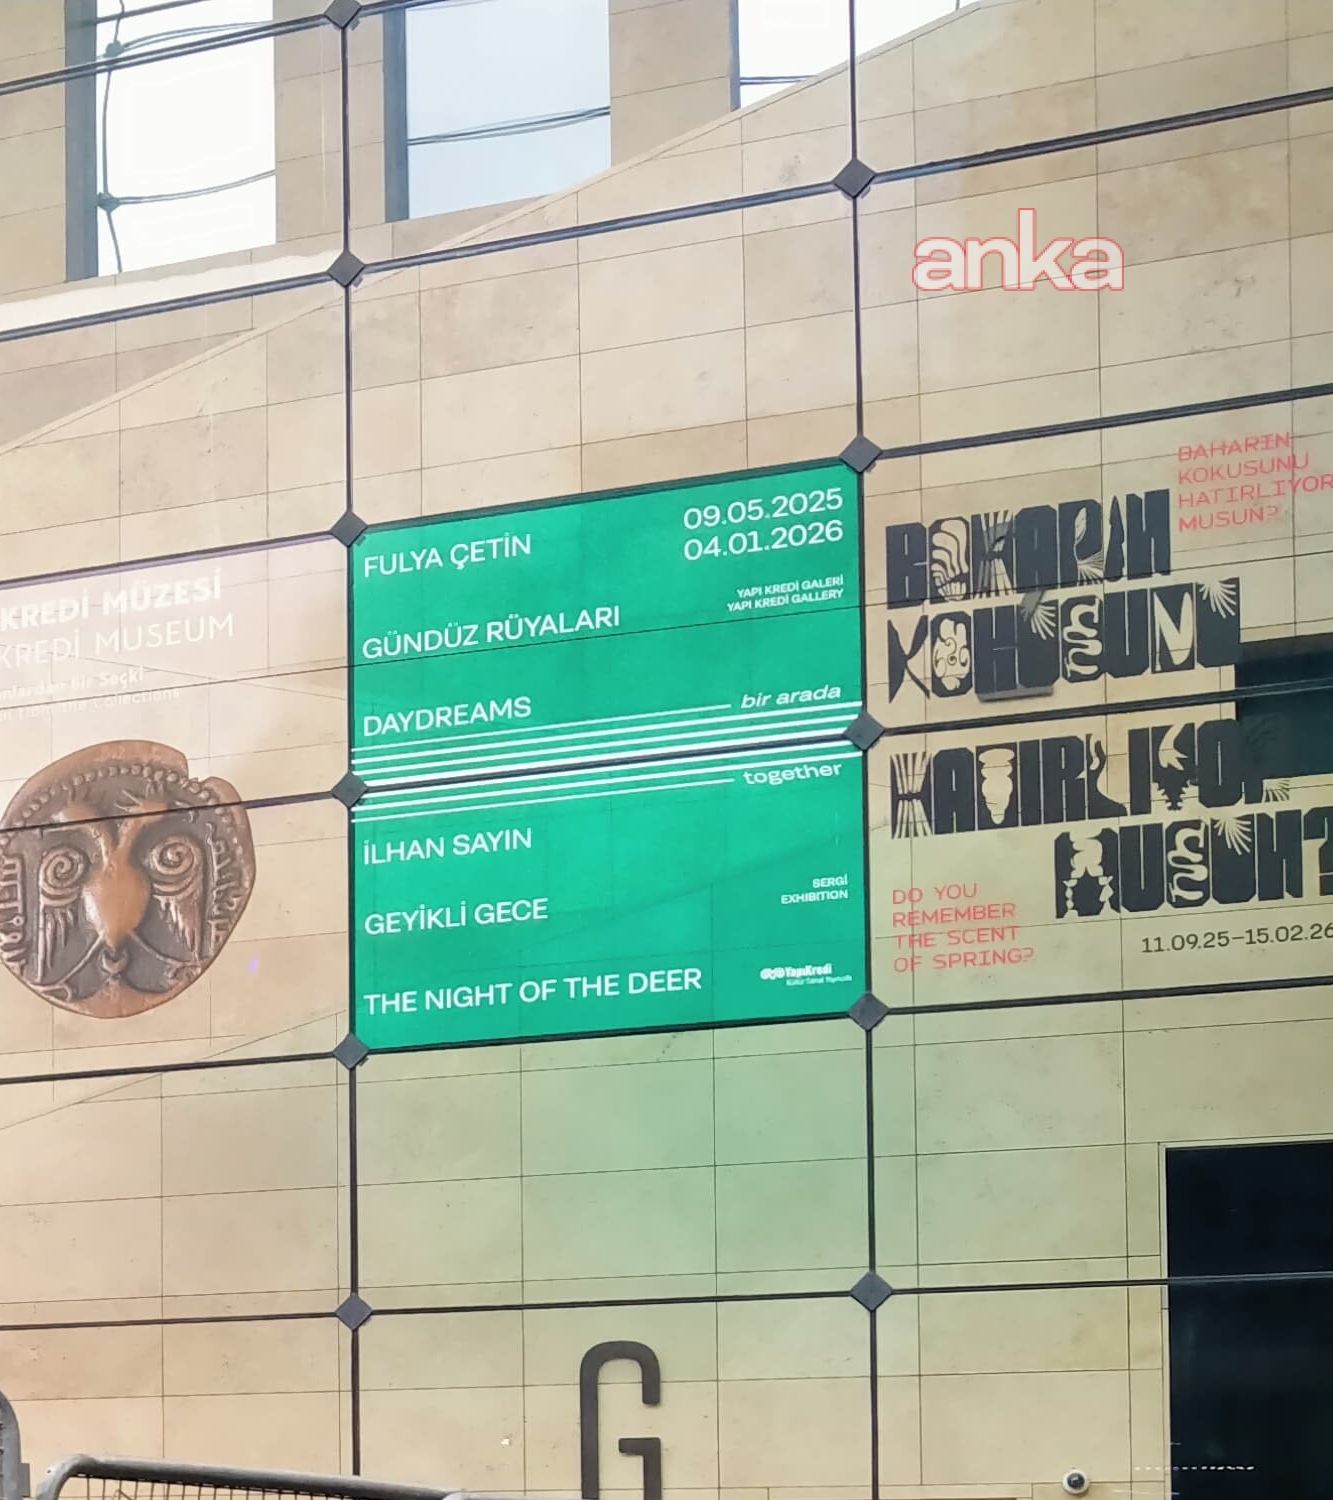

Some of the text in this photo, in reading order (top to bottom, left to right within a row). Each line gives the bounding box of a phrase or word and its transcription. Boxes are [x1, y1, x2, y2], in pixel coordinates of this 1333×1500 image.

[1178, 432, 1293, 462] BAHARIN
[1178, 451, 1309, 484] KOKUSUNU
[1178, 473, 1333, 508] HATIRLIYOR
[683, 488, 843, 529] 09.05.2025
[1178, 503, 1281, 532] MUSUN?
[364, 531, 531, 577] FULYA ÇETİN
[684, 520, 843, 560] 04.01.2026
[0, 589, 89, 632] KREDİ
[102, 568, 222, 616] MÜZESİ
[727, 587, 844, 612] YAPI KREDİ GALLERY
[736, 573, 844, 599] YAPI KREDİ GALERİ
[95, 612, 234, 656] MUSEUM
[362, 605, 620, 659] GÜNDÜZ RÜYALARI
[741, 684, 841, 709] bir arada
[363, 696, 532, 737] DAYDREAMS
[743, 763, 842, 786] together
[363, 828, 532, 865] İLHAN SAYIN
[812, 872, 848, 888] SERGİ
[892, 883, 978, 905] DO YOU
[780, 889, 849, 905] EXHIBITION
[365, 898, 549, 936] GEYİKLİ GECE
[892, 902, 1017, 929] REMEMBER
[894, 926, 1021, 950] THE SCENT
[893, 947, 1034, 974] OF SPRING?
[364, 966, 703, 1016] THE NIGHT OF THE DEER
